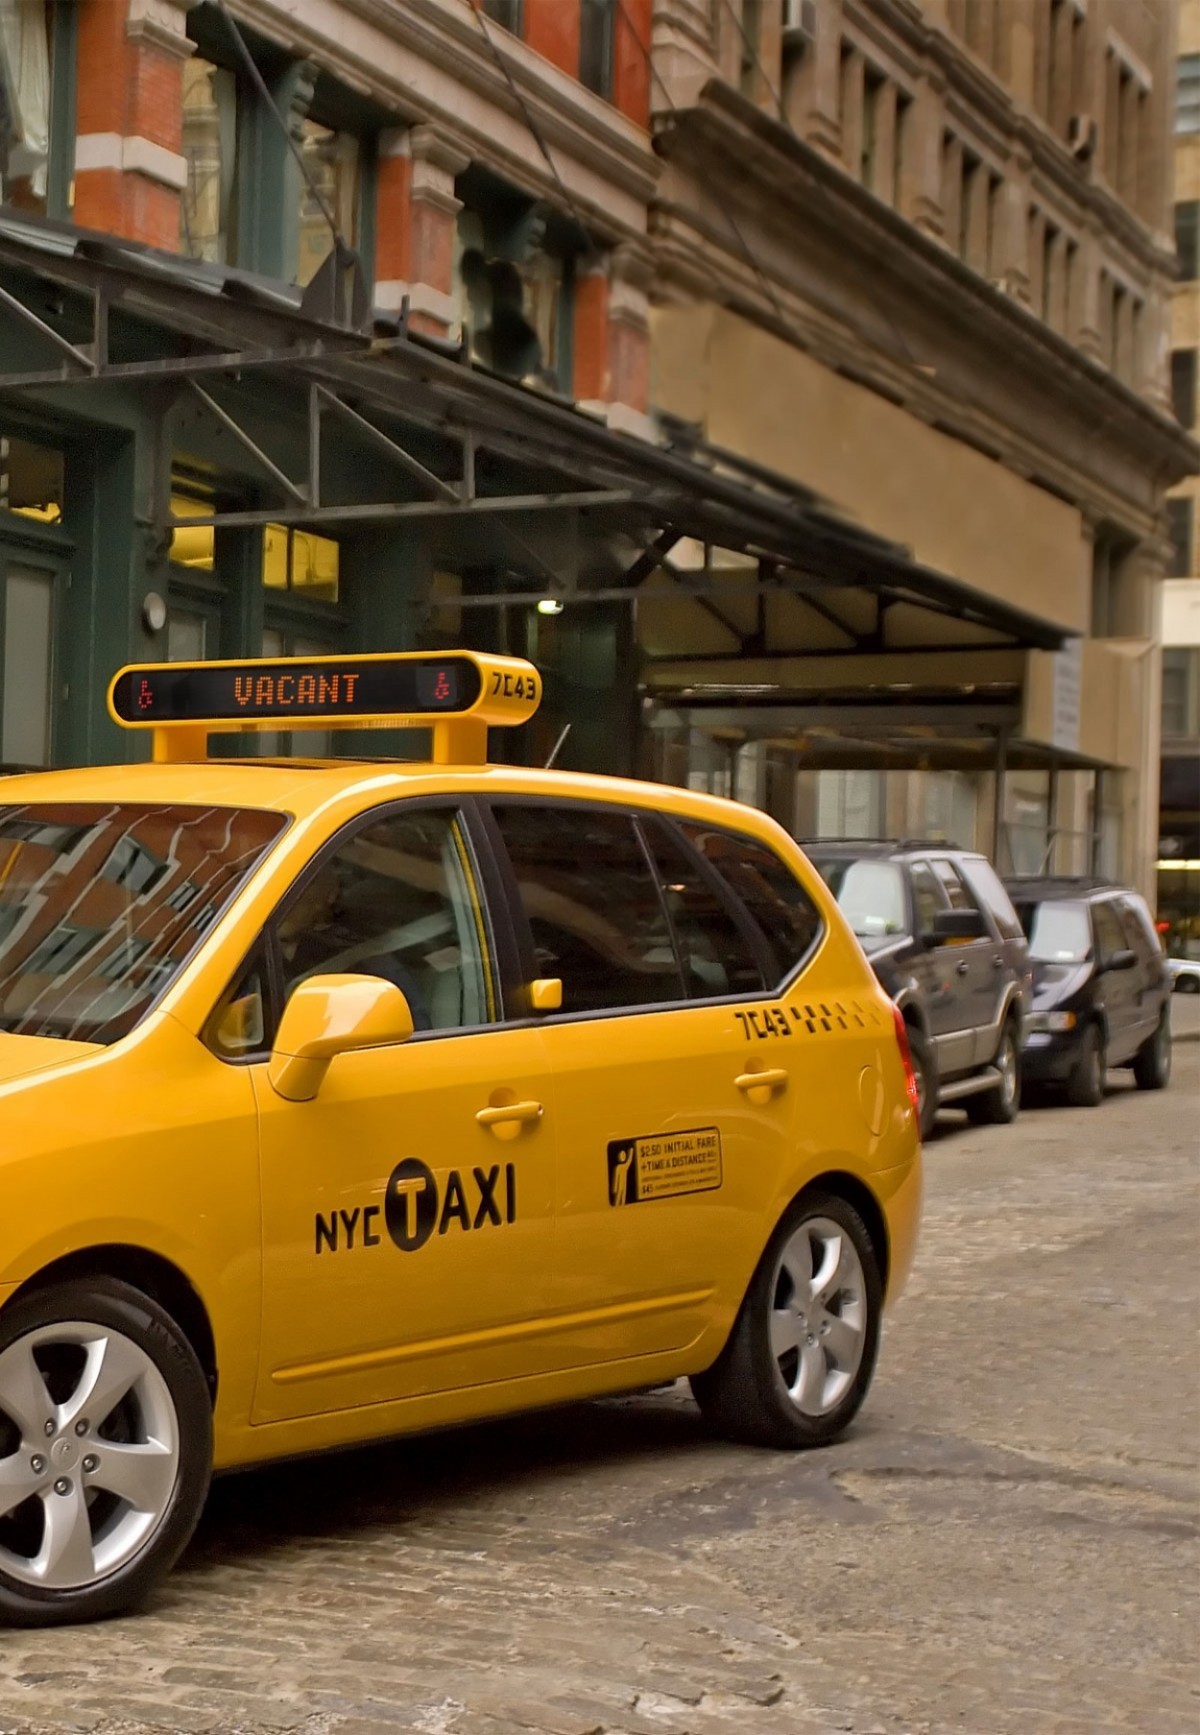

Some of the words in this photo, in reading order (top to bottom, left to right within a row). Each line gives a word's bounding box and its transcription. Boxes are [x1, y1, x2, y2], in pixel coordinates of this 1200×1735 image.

[234, 673, 359, 705] VACANT
[492, 671, 536, 700] 7C43
[734, 1008, 792, 1041] 7C43
[664, 1140, 694, 1154] INITIAL
[697, 1135, 716, 1148] FARE
[315, 1205, 381, 1255] NYC
[389, 1160, 516, 1246] TAXI
